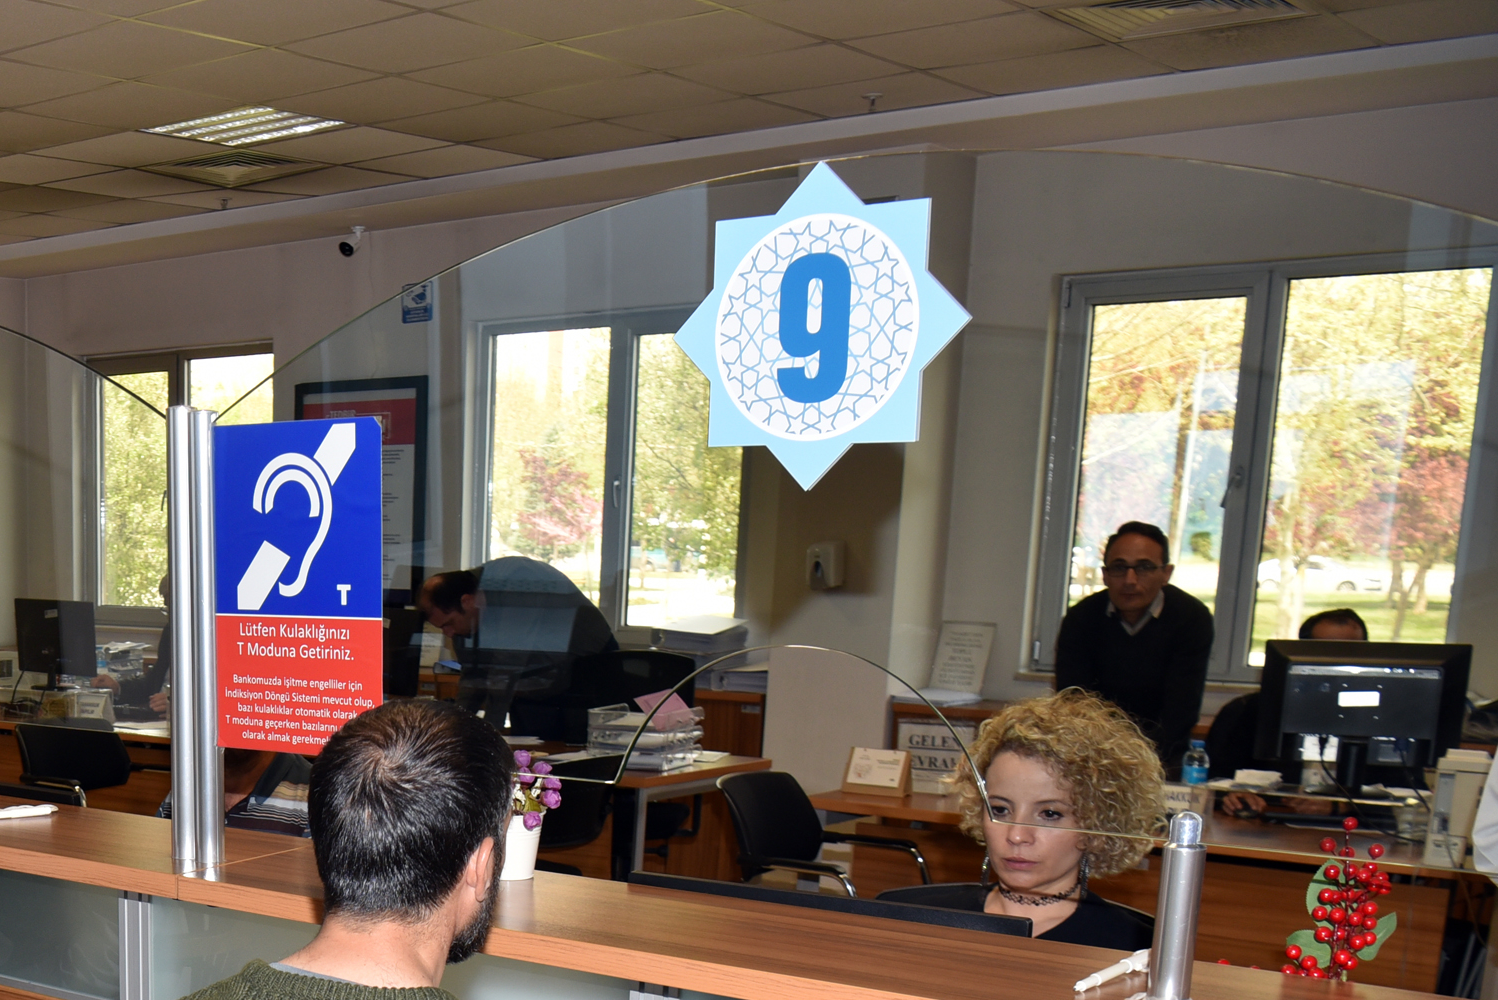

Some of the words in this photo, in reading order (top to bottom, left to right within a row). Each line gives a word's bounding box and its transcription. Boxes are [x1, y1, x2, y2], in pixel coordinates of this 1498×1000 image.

[776, 253, 851, 404] 9
[336, 584, 351, 605] T
[239, 623, 276, 637] Lütfen
[280, 623, 350, 642] Kulaklığınızı
[237, 642, 244, 655] T
[248, 643, 296, 657] Moduna
[300, 645, 354, 660] Getiriniz.
[233, 674, 281, 686] Bankomuzda
[284, 676, 307, 688] işitme
[310, 679, 346, 690] engelliler
[348, 681, 362, 692] için
[225, 687, 263, 700] İndiksiyon
[265, 691, 290, 703] Döngü
[292, 692, 320, 703] Sistemi
[322, 696, 352, 705] mevcut
[354, 697, 375, 708] olup,
[238, 702, 252, 712] bazı
[255, 704, 293, 715] kulaklıklar
[295, 708, 330, 718] otomatik
[333, 710, 358, 719] olarak
[226, 715, 230, 723] T
[233, 716, 263, 726] moduna
[265, 719, 300, 729] geçerken
[302, 721, 337, 732] bazılarını
[242, 731, 265, 740] olarak
[268, 732, 290, 742] almak
